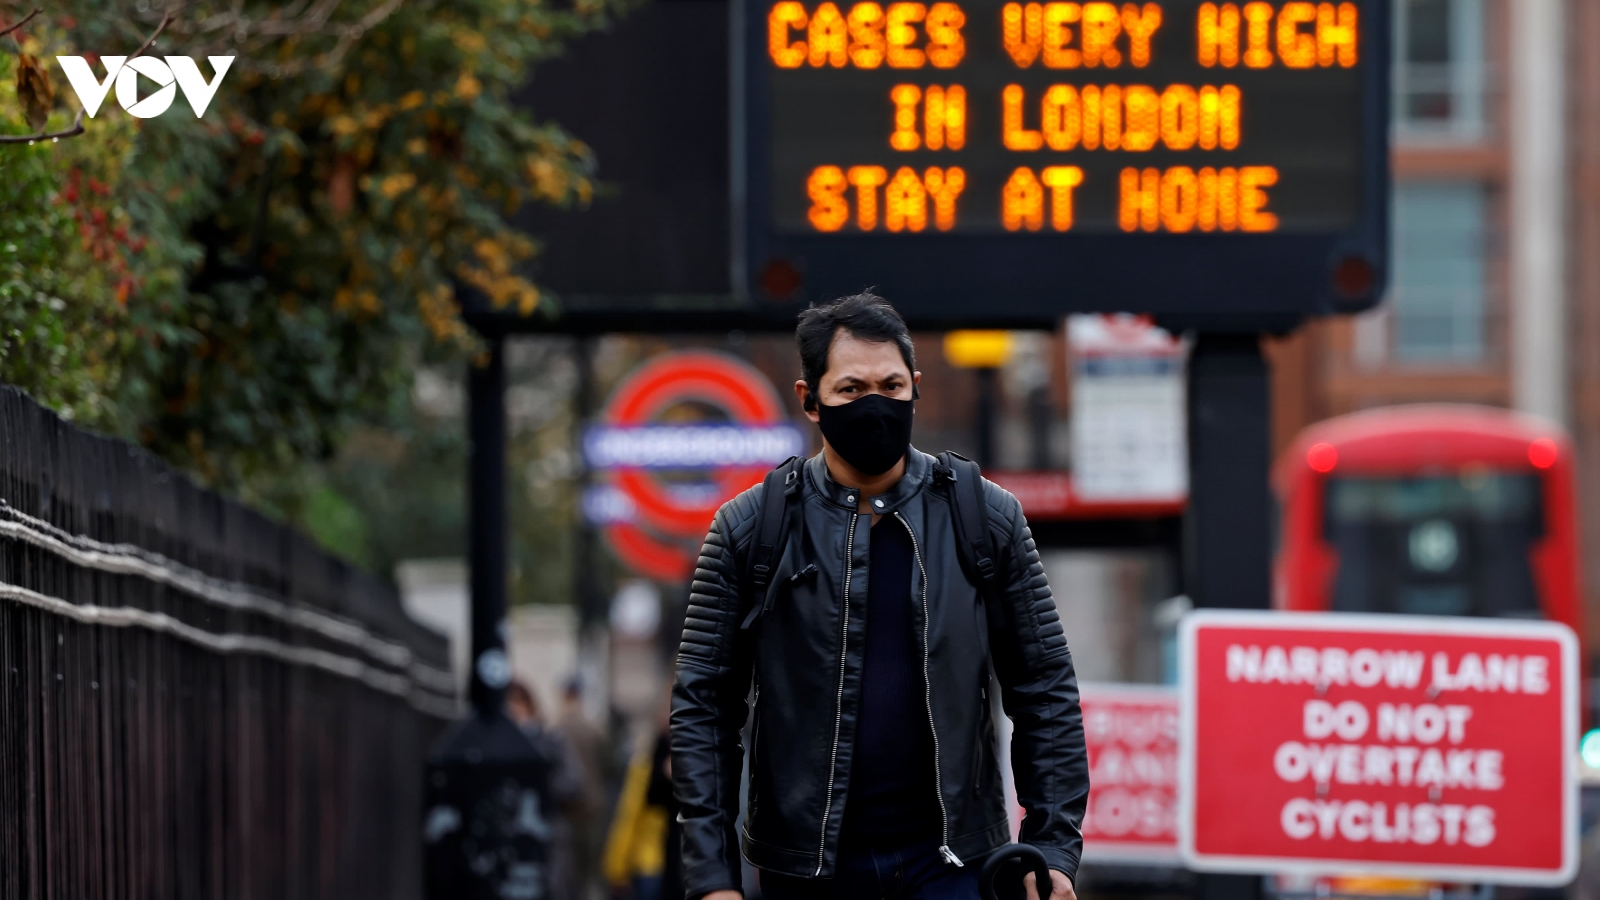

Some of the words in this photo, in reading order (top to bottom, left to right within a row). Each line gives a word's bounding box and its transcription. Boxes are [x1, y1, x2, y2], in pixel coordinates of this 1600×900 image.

[768, 1, 966, 69] CASES
[1002, 2, 1162, 69] VERY
[1197, 1, 1358, 68] HIGH
[890, 84, 967, 151] IN
[1002, 84, 1241, 151] LONDON
[807, 165, 966, 232] STAY
[1002, 165, 1084, 232] AT
[1119, 165, 1278, 232] HOME
[1226, 644, 1424, 689] NARROW
[1432, 652, 1550, 695] LANE
[1303, 700, 1369, 740] DO
[1378, 703, 1471, 744] NOT
[1274, 741, 1503, 791] OVERTAKE
[1280, 798, 1496, 848] CYCLISTS
